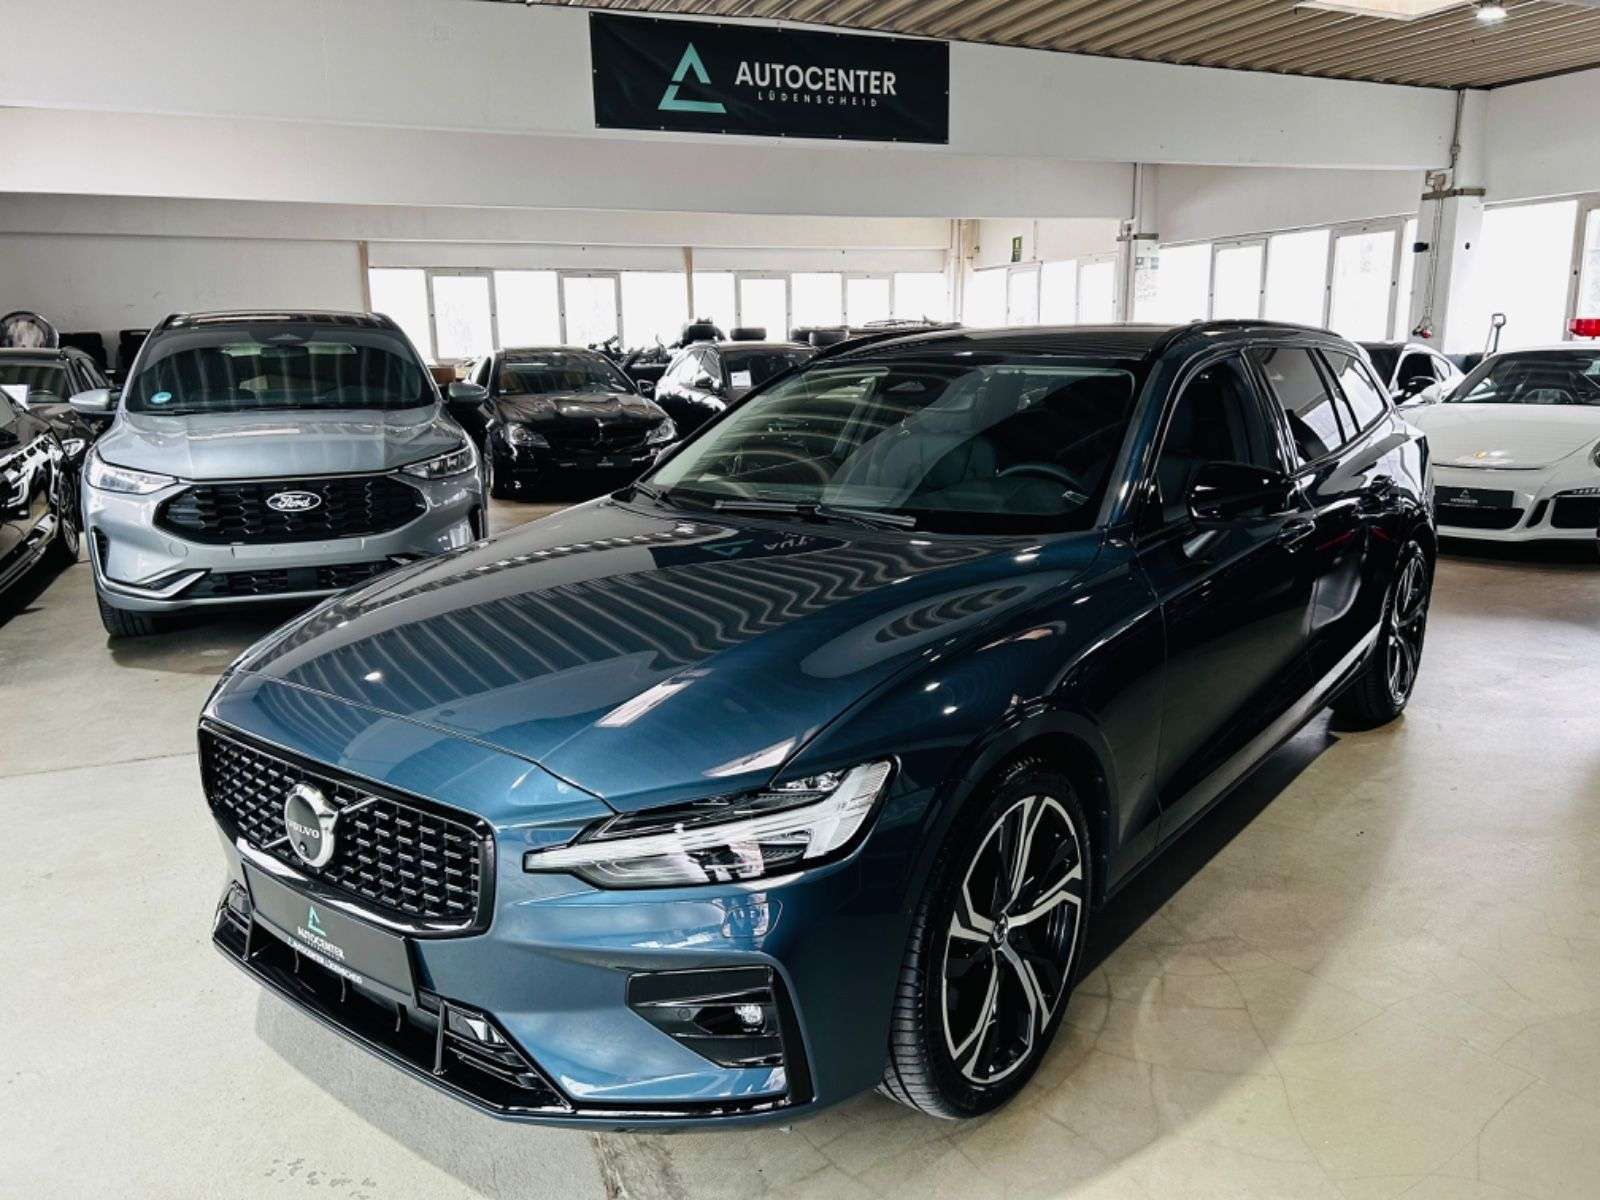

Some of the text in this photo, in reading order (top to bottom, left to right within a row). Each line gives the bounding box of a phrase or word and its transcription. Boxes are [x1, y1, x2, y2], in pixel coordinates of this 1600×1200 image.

[735, 61, 897, 95] AUTOCENTER
[758, 90, 877, 107] LÜDENSCHEID
[276, 494, 312, 509] Ford
